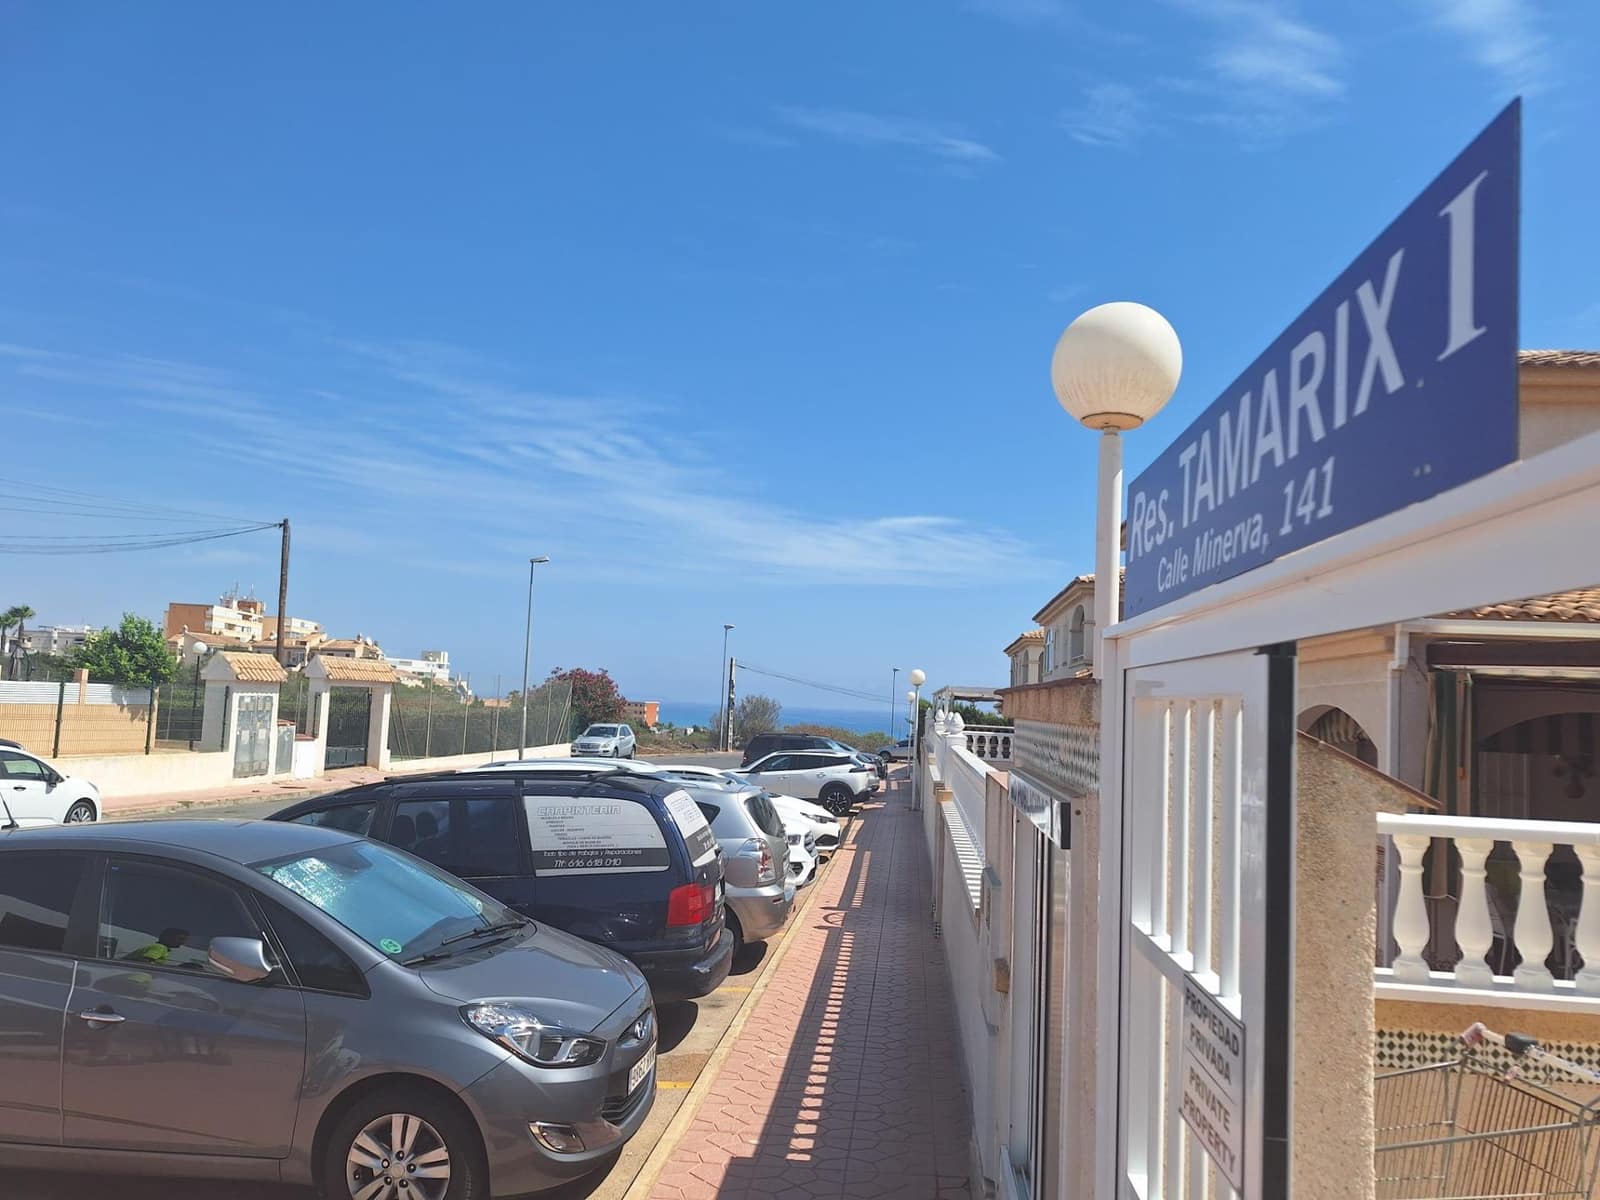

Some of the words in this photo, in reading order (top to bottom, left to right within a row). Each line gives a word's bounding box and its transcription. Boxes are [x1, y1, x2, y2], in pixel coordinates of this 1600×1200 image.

[1129, 489, 1174, 562] Res.
[1179, 248, 1405, 528] TAMARIX
[1437, 170, 1488, 361] I
[1157, 547, 1188, 592] Calle
[1192, 513, 1269, 577] Minerva,
[1279, 456, 1335, 536] 141
[537, 805, 622, 816] CARPINTERIA
[567, 859, 585, 868] 616
[604, 857, 622, 867] 010
[1184, 988, 1239, 1057] PROPIEDAD
[1189, 1022, 1231, 1085] PRIVADA
[1183, 1090, 1236, 1174] PROPERTY
[1189, 1066, 1231, 1133] PRIVATE
